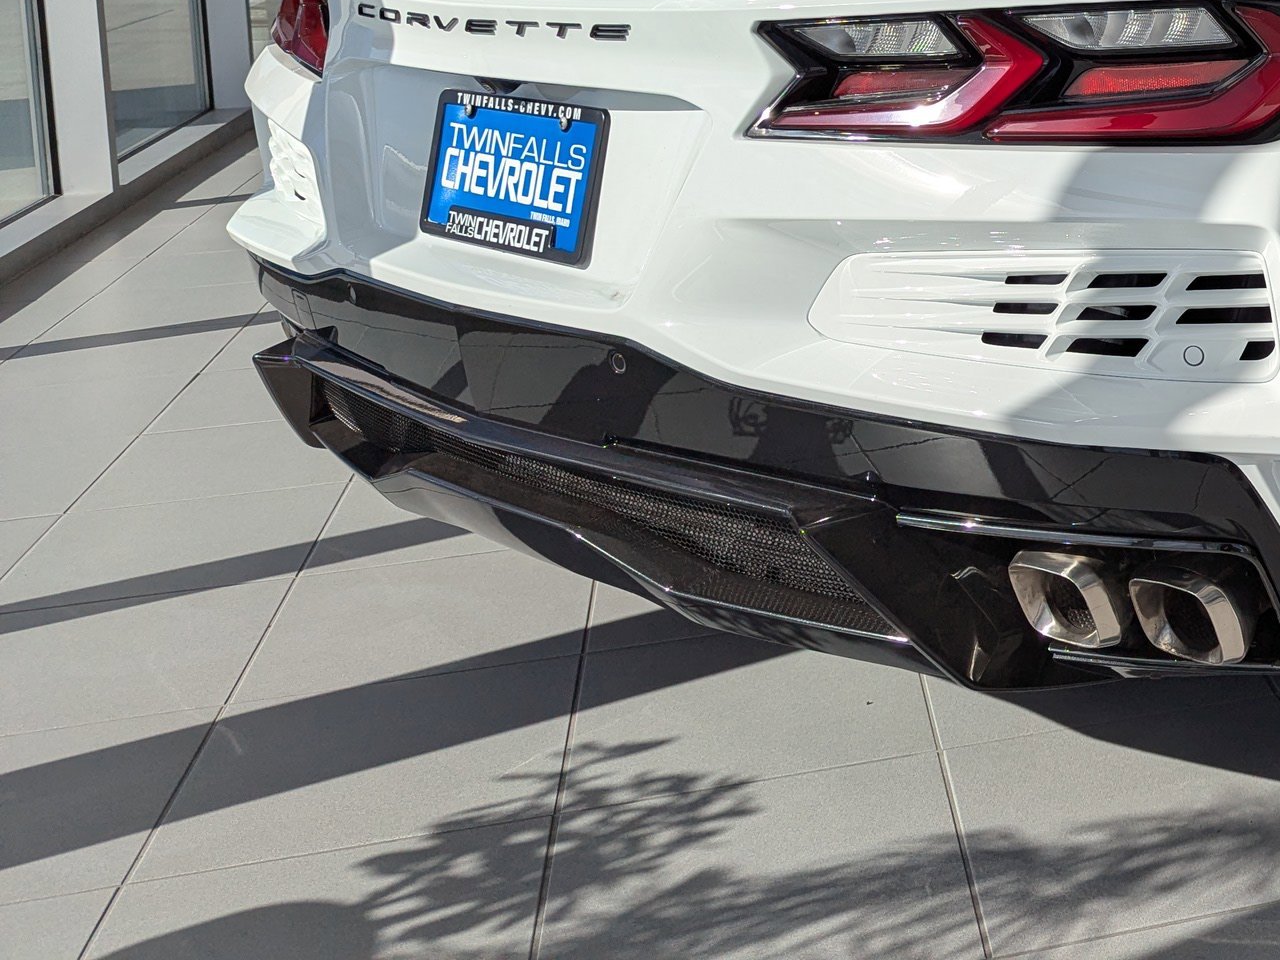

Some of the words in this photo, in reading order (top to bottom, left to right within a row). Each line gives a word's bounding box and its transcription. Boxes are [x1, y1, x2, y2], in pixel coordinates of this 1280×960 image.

[358, 3, 632, 42] CORVETTE
[457, 93, 582, 120] TWINFALLS-CHEVY.COM
[441, 147, 583, 214] CHEVROLET
[445, 223, 475, 238] FALLS
[449, 211, 477, 227] TWIN
[474, 217, 549, 253] CHEVROLET
